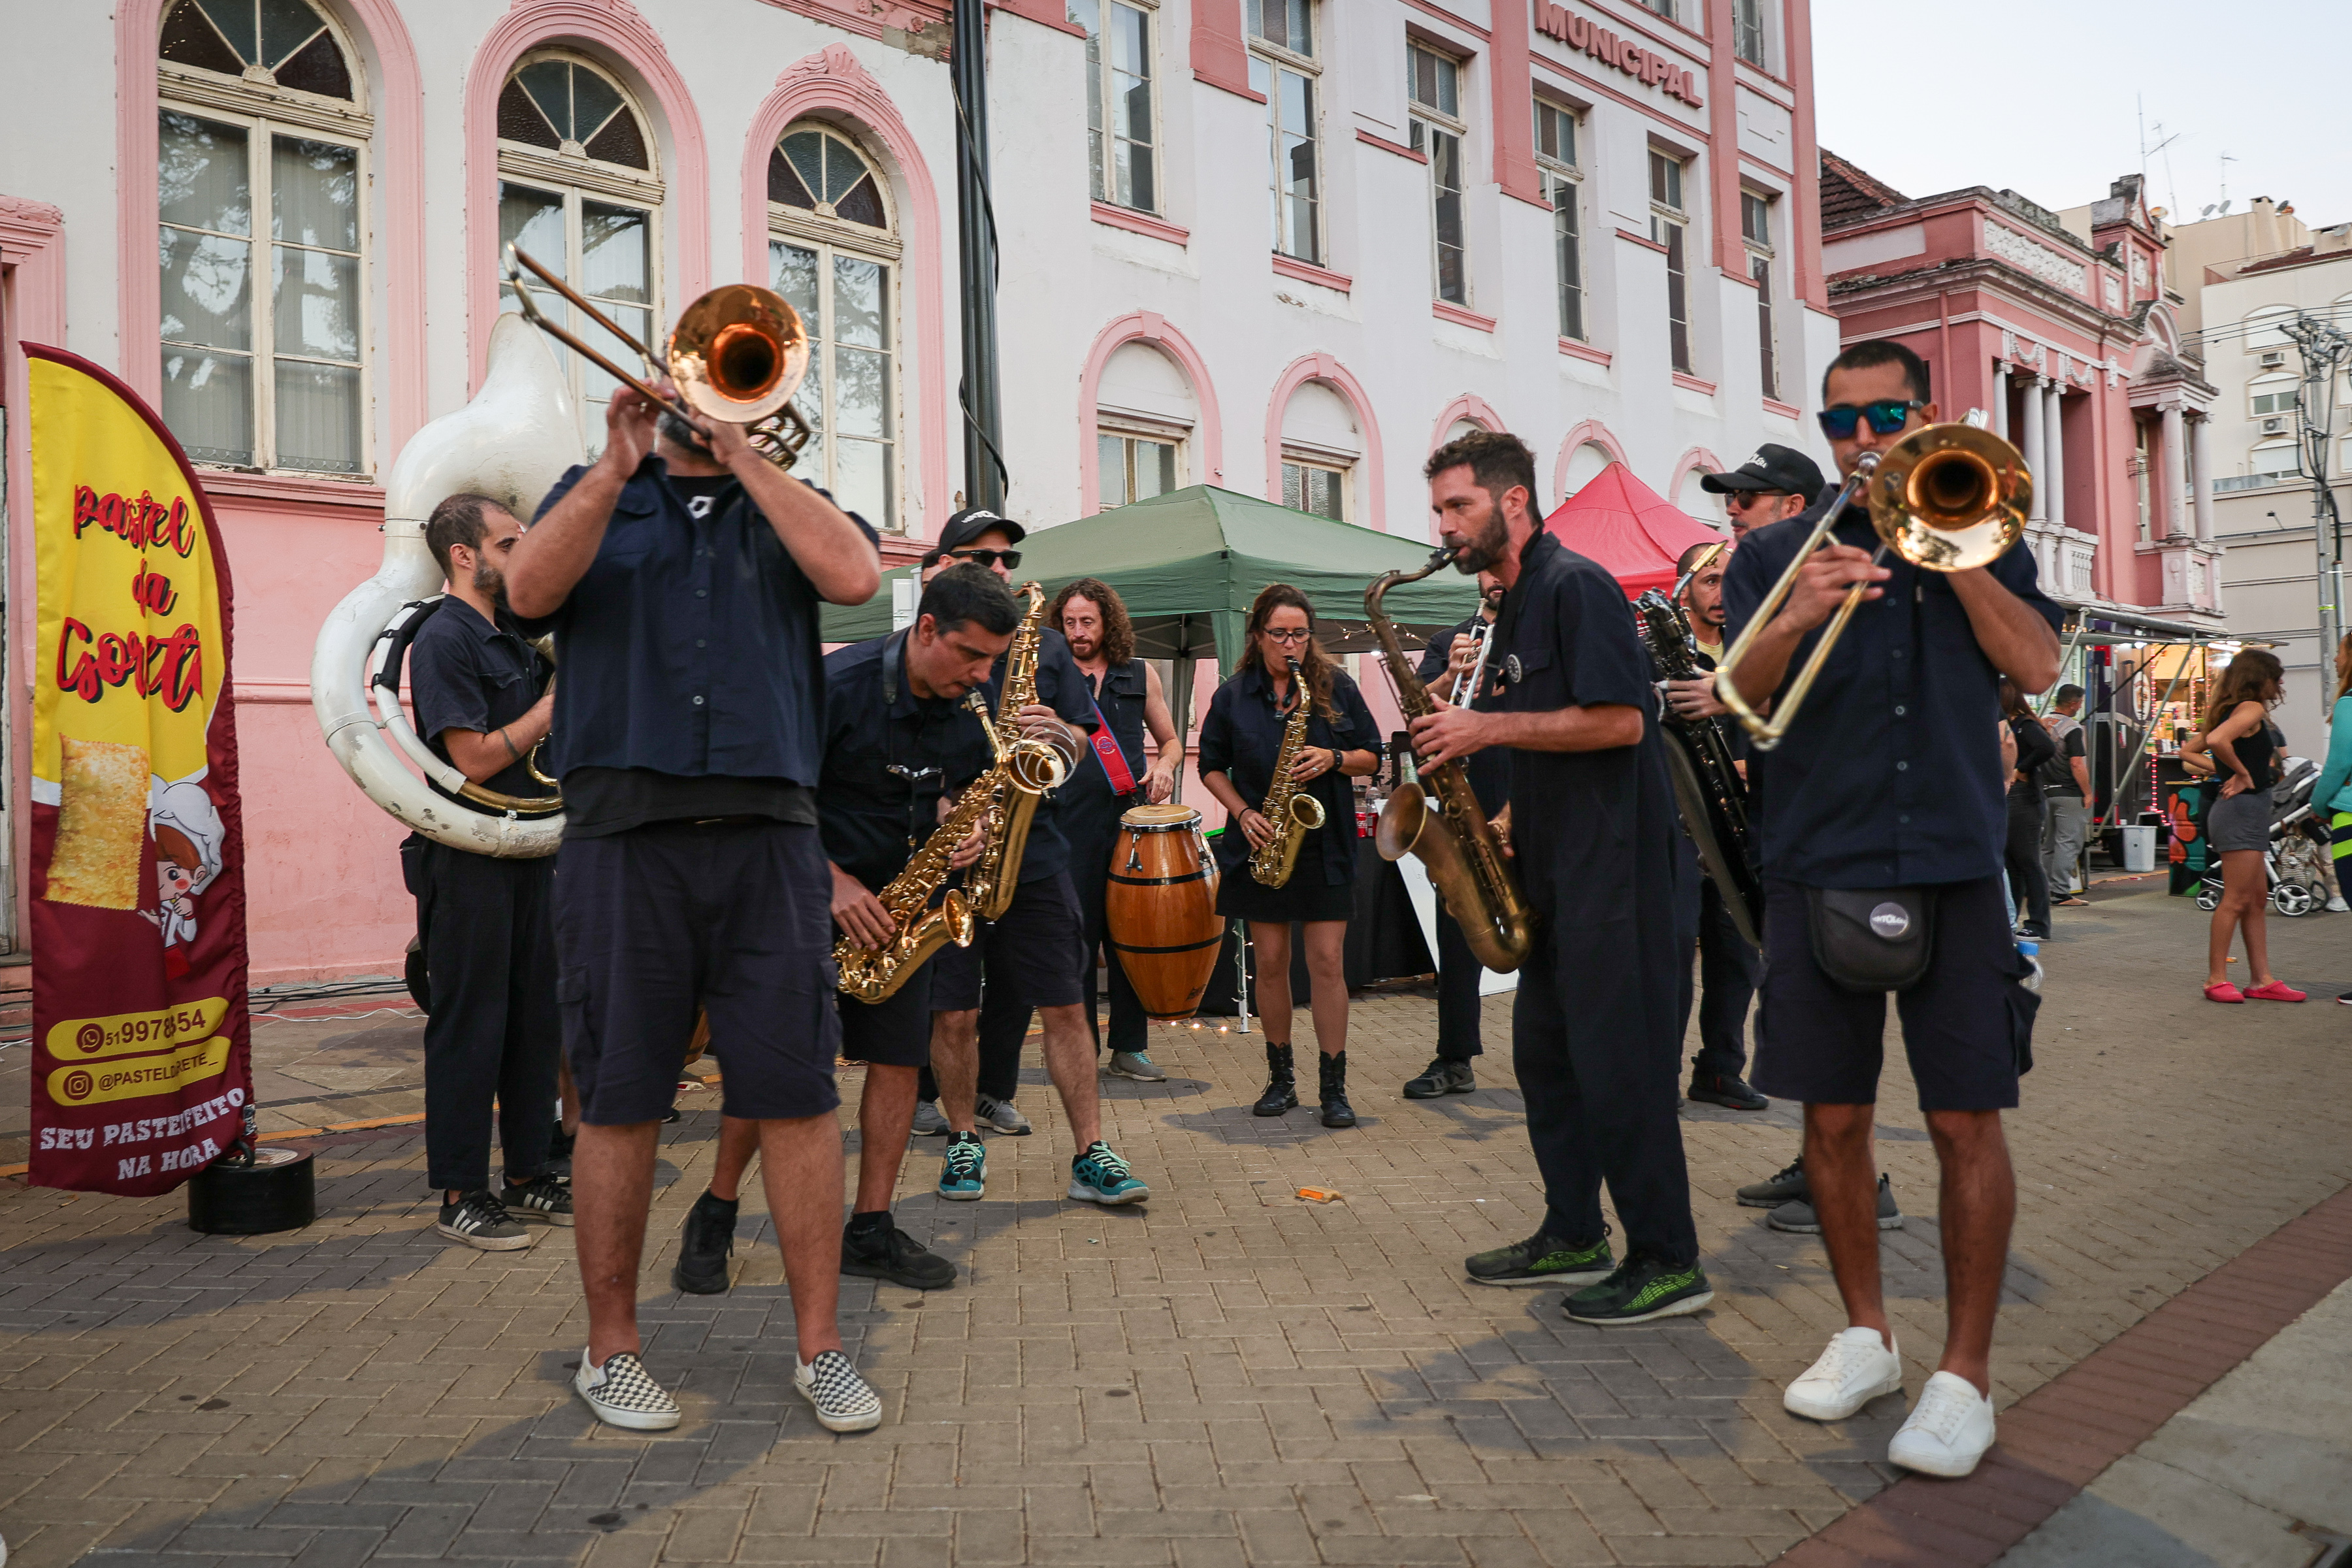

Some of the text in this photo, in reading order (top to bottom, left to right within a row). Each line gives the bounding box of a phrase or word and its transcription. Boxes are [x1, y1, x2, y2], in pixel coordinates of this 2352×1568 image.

[1535, 0, 1703, 108] MUNICIPAL
[132, 558, 178, 616] da
[40, 1127, 95, 1150] SEU
[118, 1137, 221, 1180] NA HORA
